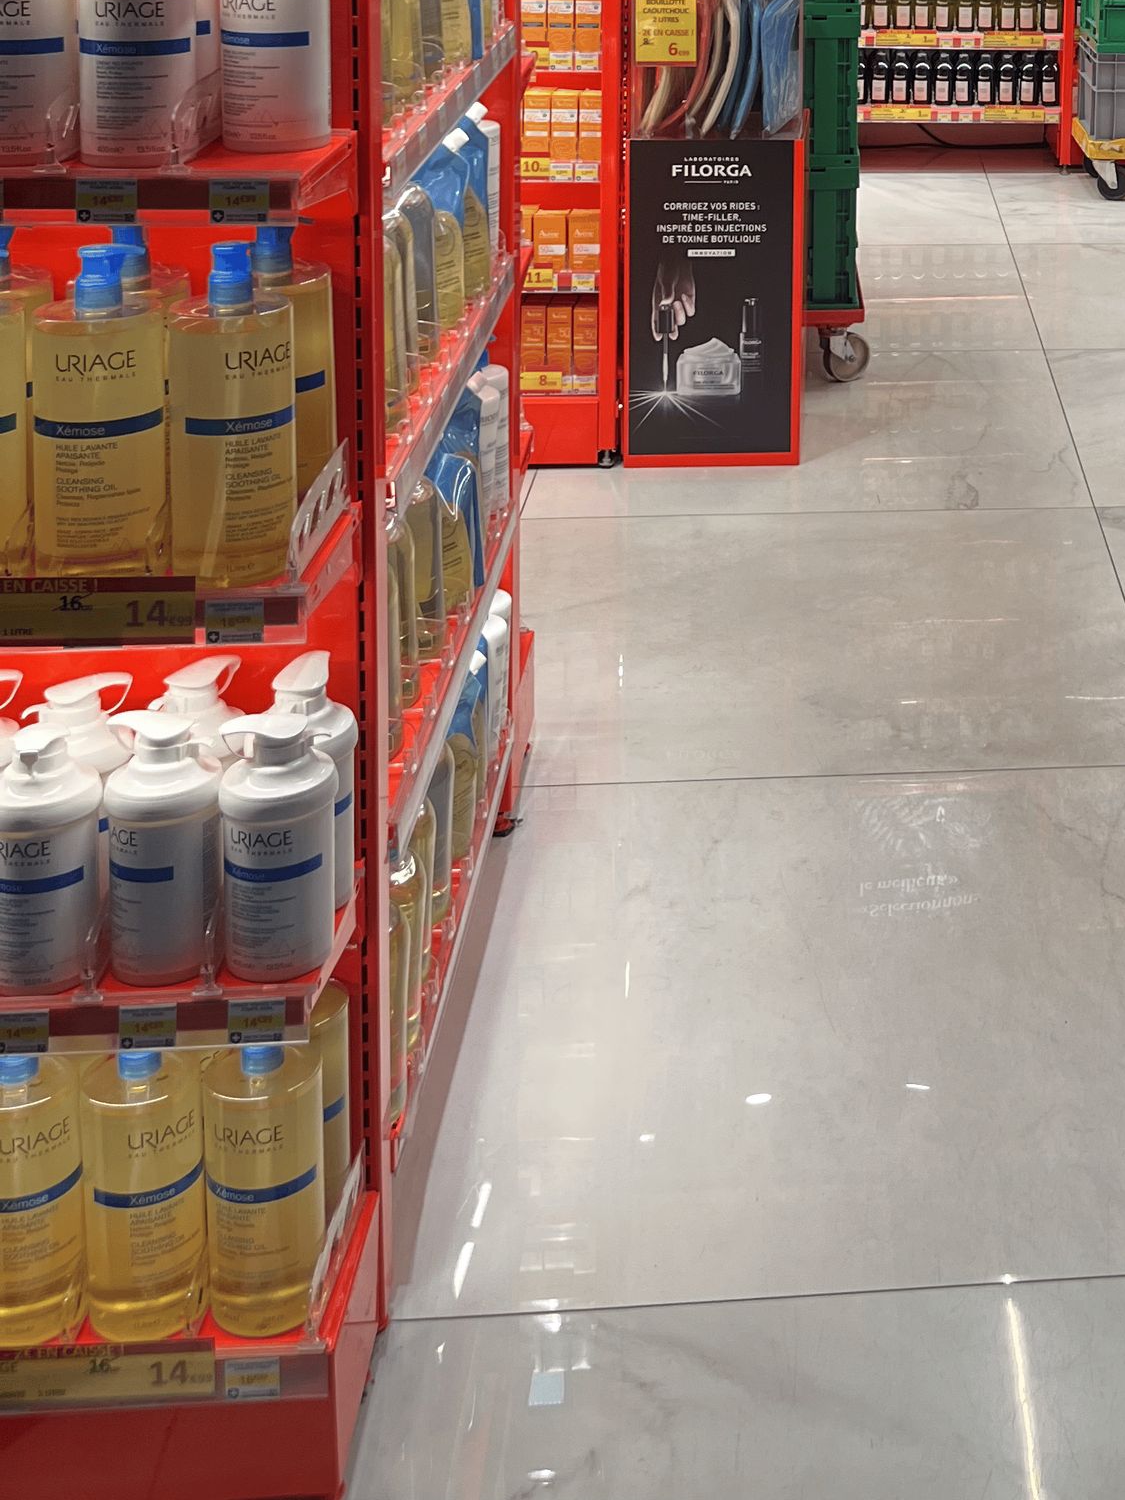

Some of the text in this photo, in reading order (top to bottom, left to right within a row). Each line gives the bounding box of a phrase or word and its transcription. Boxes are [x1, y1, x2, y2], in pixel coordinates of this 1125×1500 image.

[95, 2, 164, 21] URIAGE
[672, 164, 752, 177] FILORGA
[664, 202, 756, 210] CORRIGEZ VOS RIDES
[682, 213, 741, 221] TIME-FILLER,
[657, 222, 767, 232] INSPIRÉ DES INJECTIONS
[662, 235, 761, 243] DE TOXINE BOTULIQUE
[55, 350, 136, 375] URIAGE
[225, 341, 291, 372] URIAGE
[56, 425, 106, 436] Xémose
[225, 417, 273, 432] Xémose
[80, 442, 118, 451] LAVANTE
[56, 477, 104, 485] CLEANSING
[56, 484, 117, 493] SOOTHING OIL
[4, 580, 26, 592] EN
[31, 579, 89, 593] CAISSE
[230, 829, 292, 854] URIAGE
[128, 1109, 194, 1151] URIAGE
[214, 1124, 284, 1147] URIAGE
[1, 1193, 49, 1210] Xémose
[129, 1187, 176, 1206] Xémose
